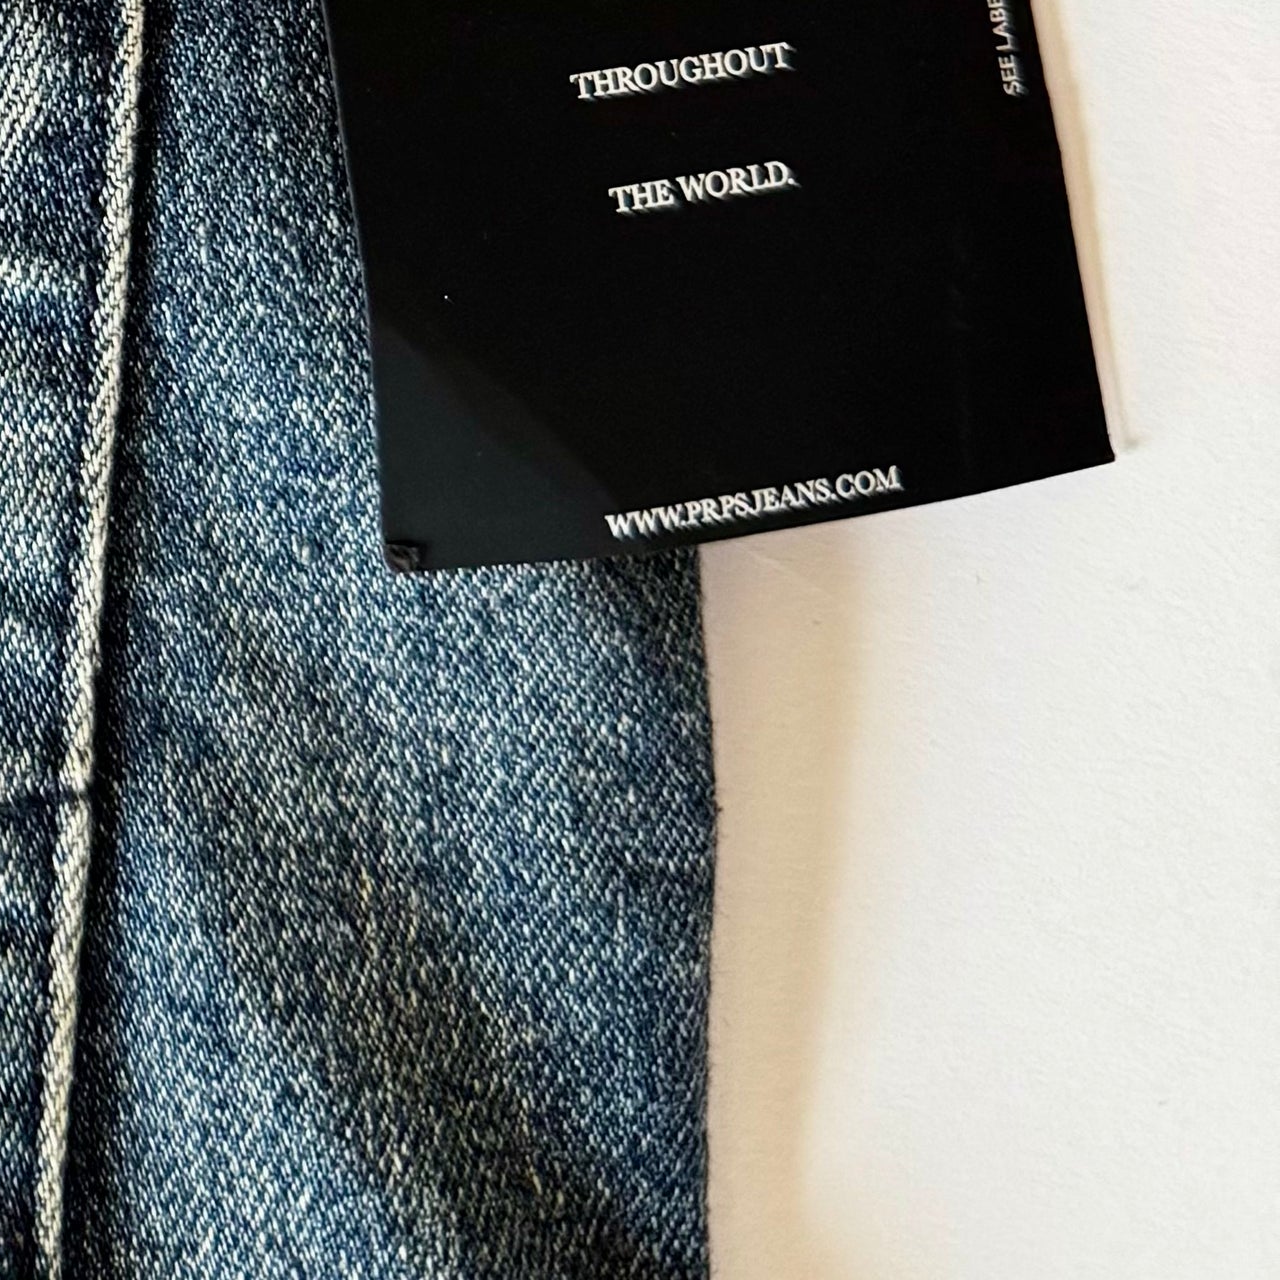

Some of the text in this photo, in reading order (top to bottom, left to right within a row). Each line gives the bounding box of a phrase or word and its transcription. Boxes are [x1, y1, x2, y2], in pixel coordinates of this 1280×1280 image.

[569, 41, 794, 100] THROUGHOUT
[998, 54, 1023, 97] SEE
[608, 160, 796, 214] THE WORLD.
[604, 465, 902, 540] WWW.PRPSJEANS.COM
